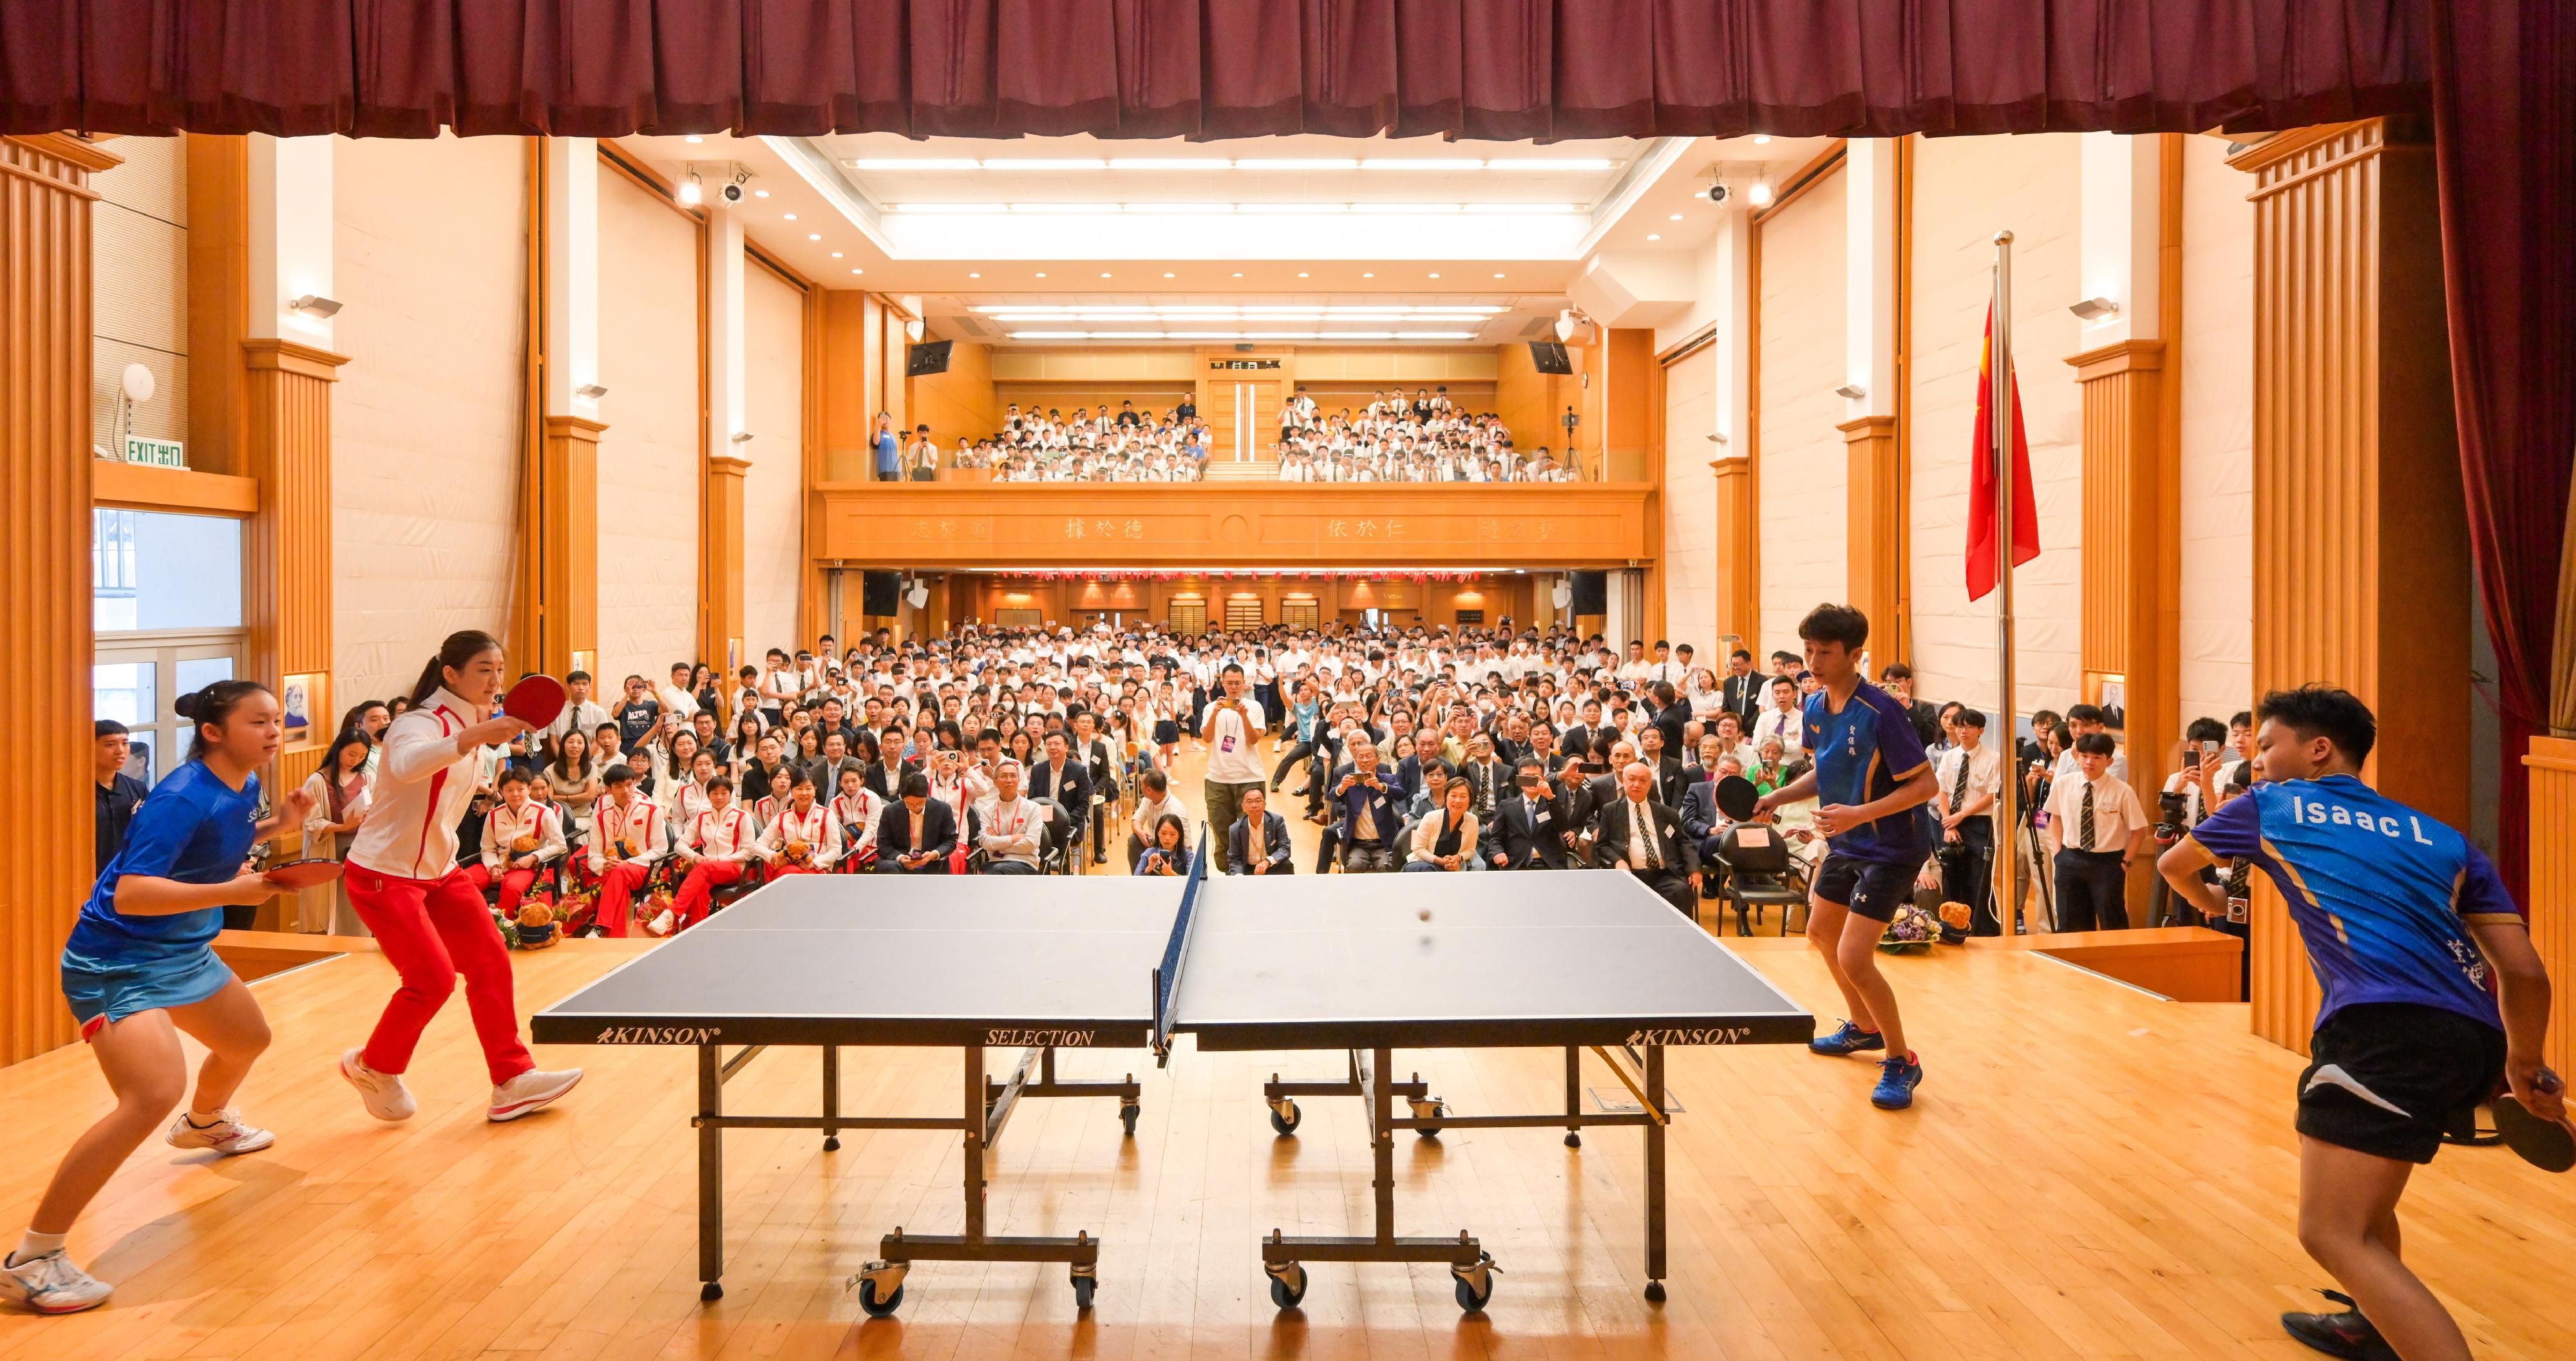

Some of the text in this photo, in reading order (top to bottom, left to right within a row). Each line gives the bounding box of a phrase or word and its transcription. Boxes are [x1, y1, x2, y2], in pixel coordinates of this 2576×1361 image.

[129, 441, 156, 464] EXIT
[158, 444, 180, 466] 出口
[912, 519, 989, 540] 志於道
[1065, 517, 1144, 539] 據於德
[1327, 518, 1406, 538] 依於仁
[2293, 796, 2433, 846] Isaac L
[985, 1029, 1095, 1047] SELECTION
